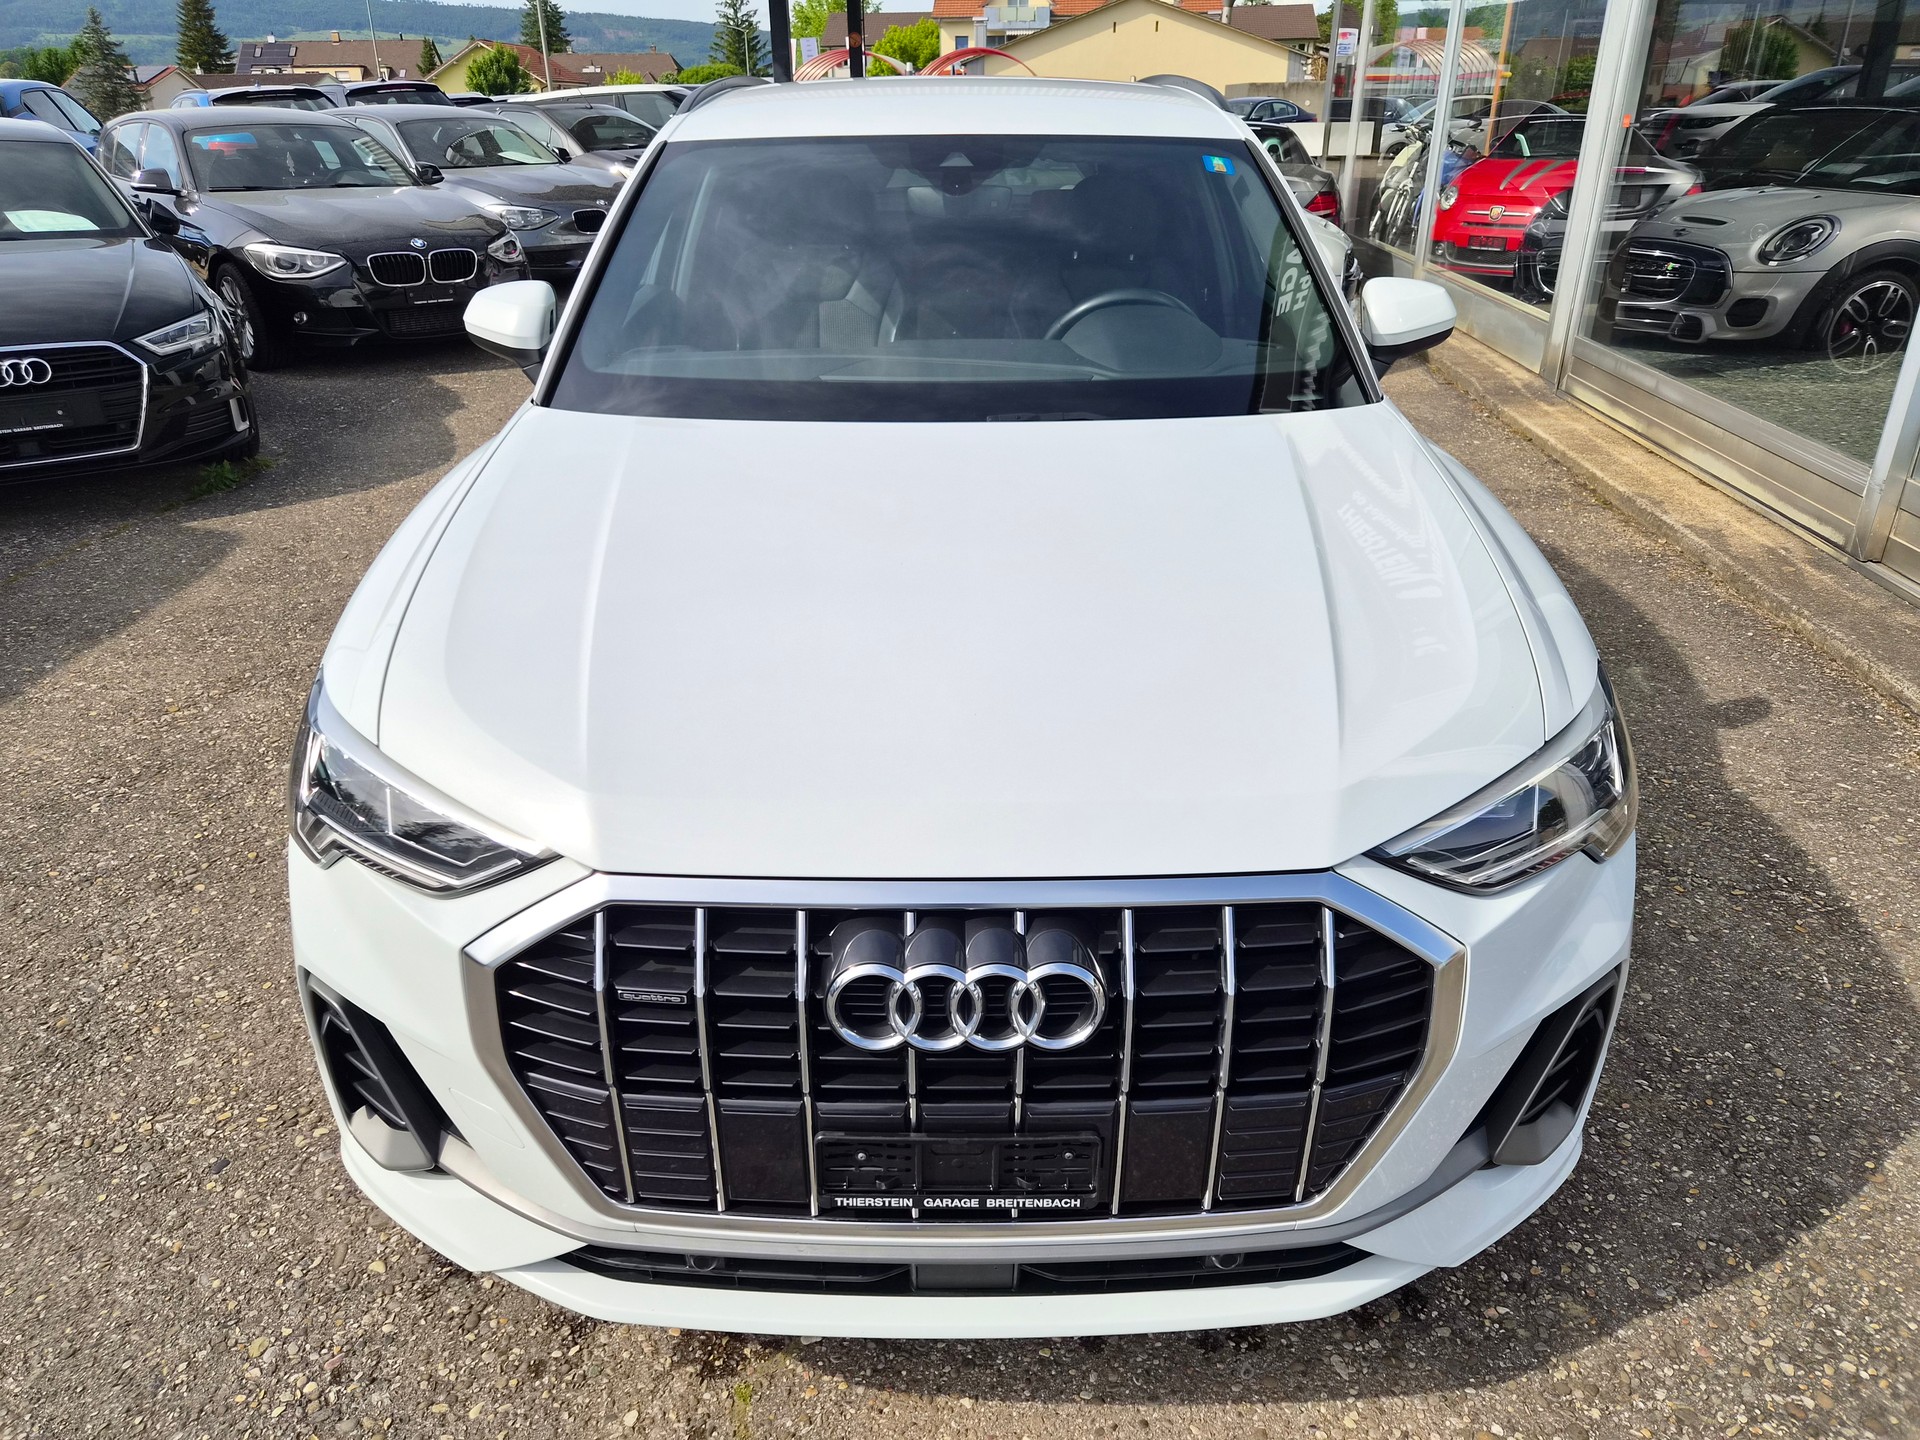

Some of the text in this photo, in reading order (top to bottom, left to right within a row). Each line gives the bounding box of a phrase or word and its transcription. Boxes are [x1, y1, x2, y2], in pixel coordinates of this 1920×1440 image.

[623, 993, 681, 1002] quattro
[835, 1197, 1081, 1208] THIERSTEIN GARAGE BREITENBACH
